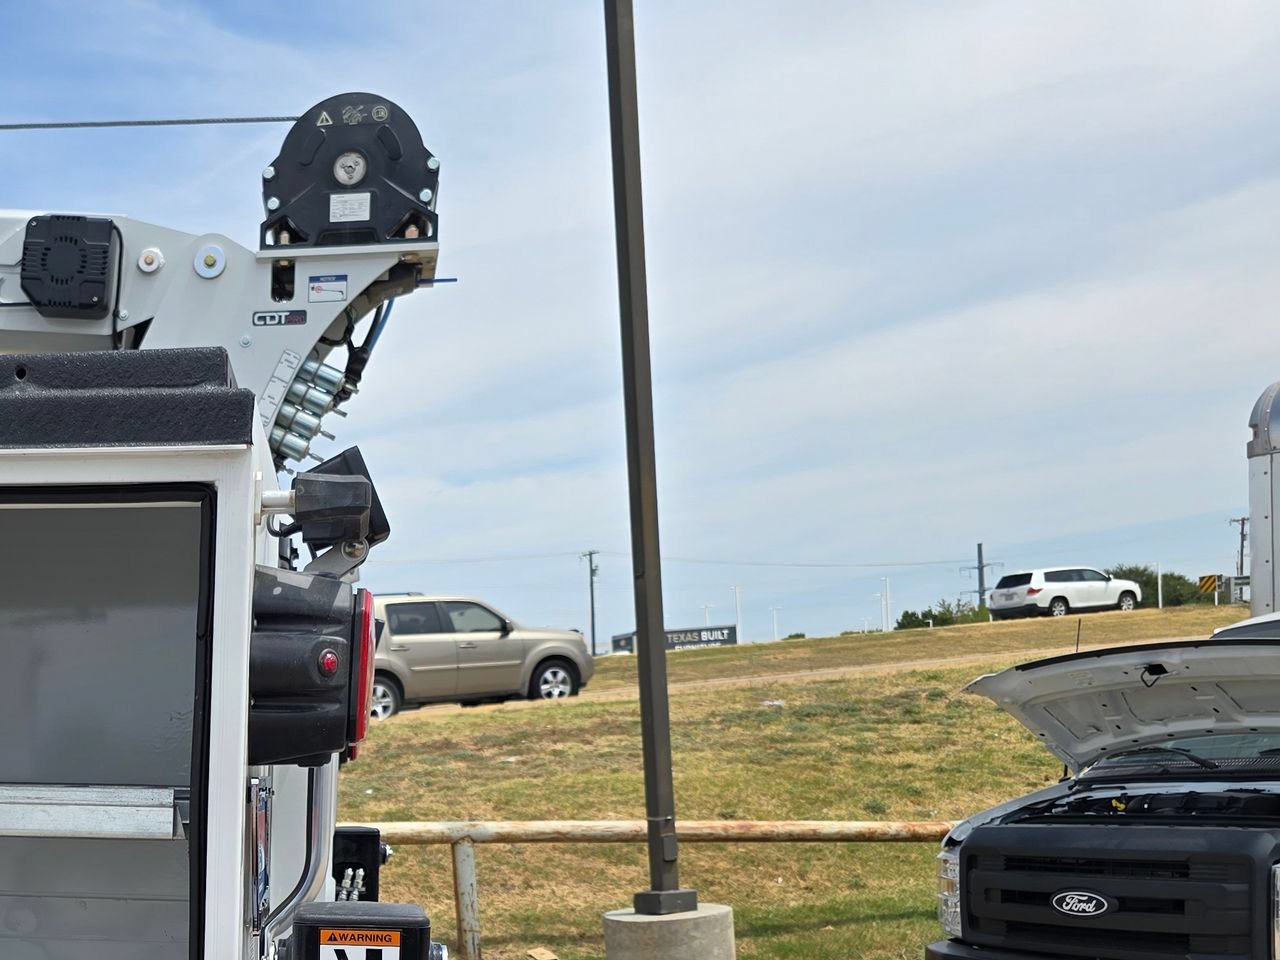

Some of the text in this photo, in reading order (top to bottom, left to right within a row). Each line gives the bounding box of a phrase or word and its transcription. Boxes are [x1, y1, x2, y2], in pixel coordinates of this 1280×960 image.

[667, 629, 729, 643] TEXAS BUILT
[1062, 895, 1096, 912] Ford
[338, 933, 392, 943] WARNING
